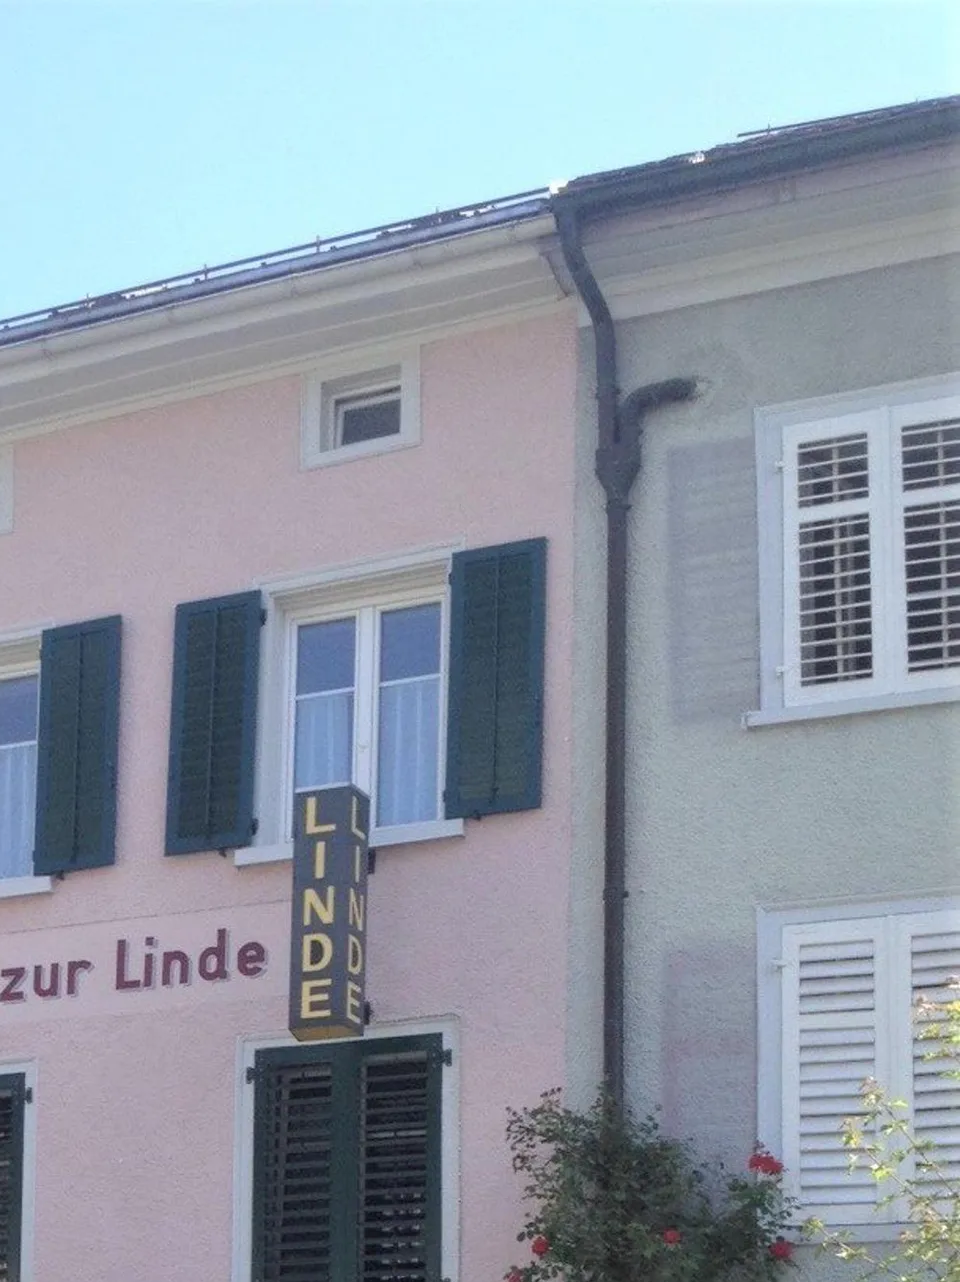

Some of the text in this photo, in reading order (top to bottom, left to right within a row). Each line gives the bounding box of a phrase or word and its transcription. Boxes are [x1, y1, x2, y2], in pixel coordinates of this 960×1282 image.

[0, 958, 92, 1004] zur
[115, 927, 267, 992] Linde
[299, 795, 337, 1020] LINDE
[345, 795, 366, 1025] LINDE
